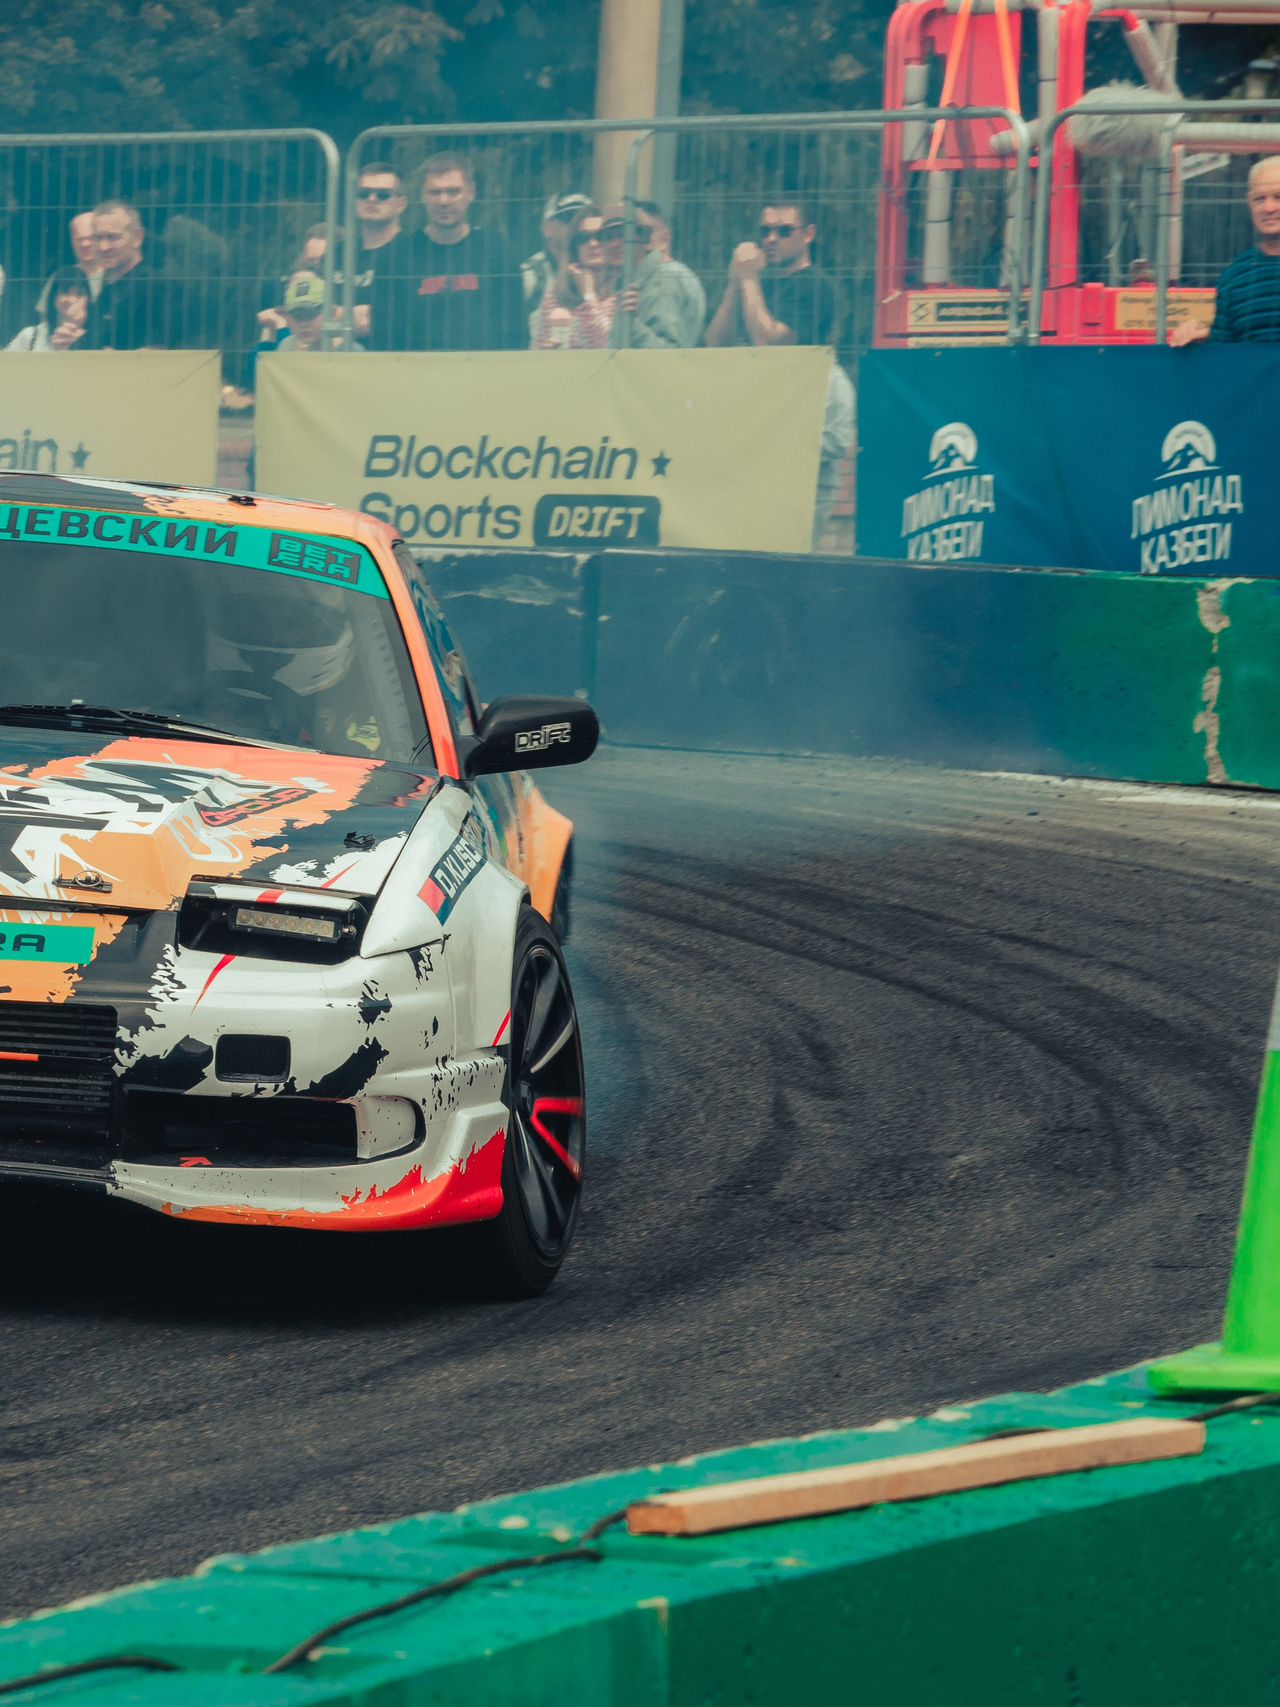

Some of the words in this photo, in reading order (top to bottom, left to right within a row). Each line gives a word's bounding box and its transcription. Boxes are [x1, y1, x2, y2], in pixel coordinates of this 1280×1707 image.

[364, 435, 638, 479] Blockchain
[547, 506, 646, 538] DRIFT
[901, 474, 995, 538] ЛИМОНАД
[1131, 475, 1243, 539] ЛИМОНАД
[278, 537, 353, 565] BET
[907, 520, 983, 562] КАЗБЕГИ
[1141, 522, 1231, 574] КАЗБЕГИ
